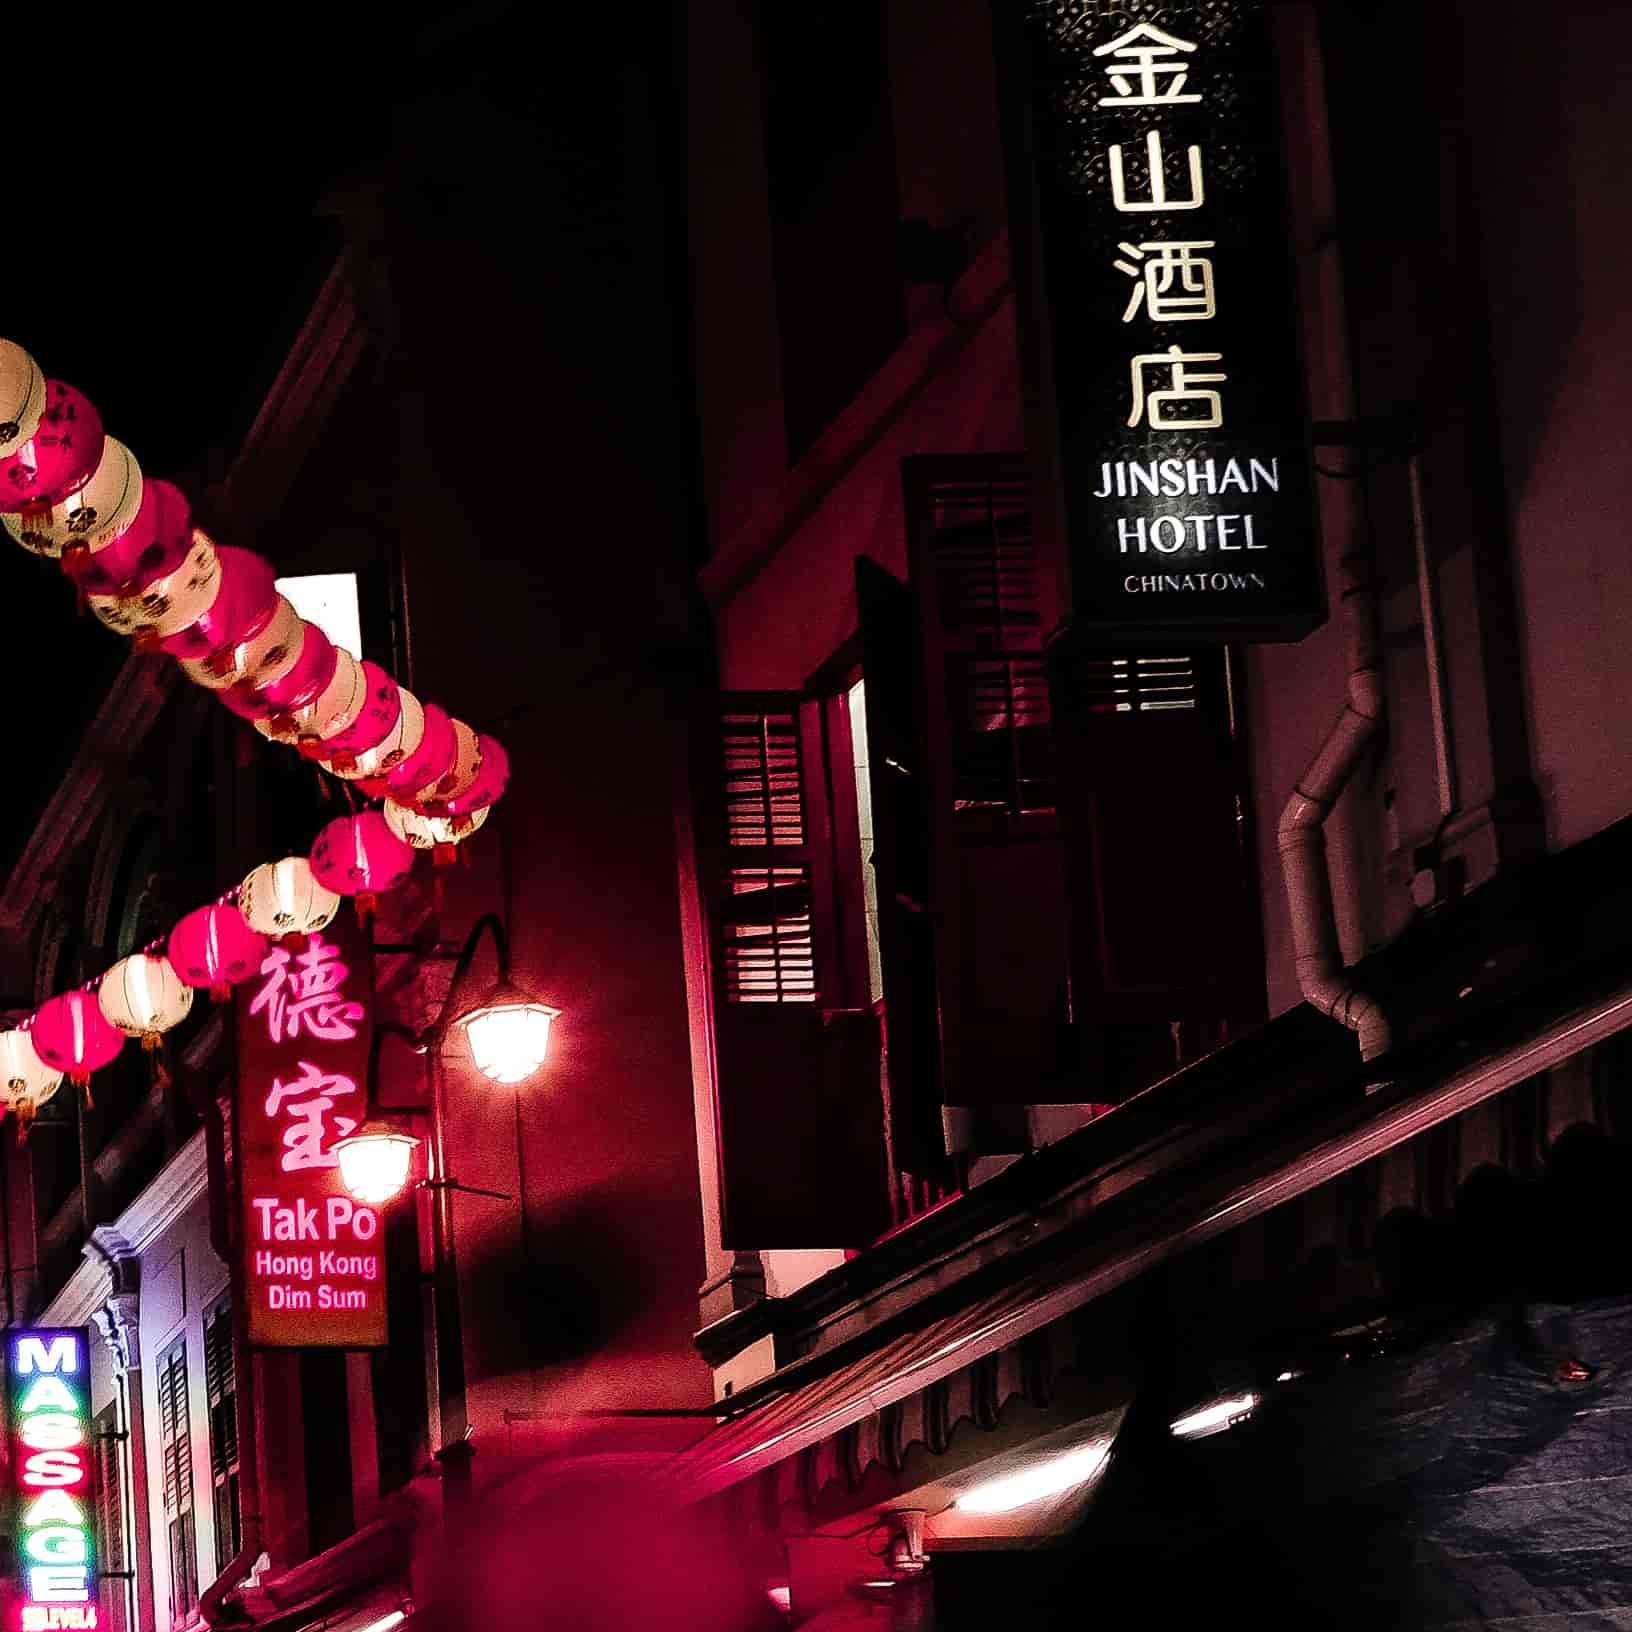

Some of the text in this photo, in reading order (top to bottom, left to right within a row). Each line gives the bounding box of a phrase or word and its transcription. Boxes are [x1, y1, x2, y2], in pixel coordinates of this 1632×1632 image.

[1093, 23, 1227, 431] 金山酒店
[1093, 457, 1281, 498] JINSHAN
[1118, 514, 1268, 554] HOTEL
[1123, 571, 1266, 594] CHINATOWN
[253, 1198, 377, 1240] Tak Po
[256, 1251, 377, 1280] Hong Kong
[269, 1285, 366, 1310] Dim Sum
[17, 1335, 88, 1601] MASSAGE
